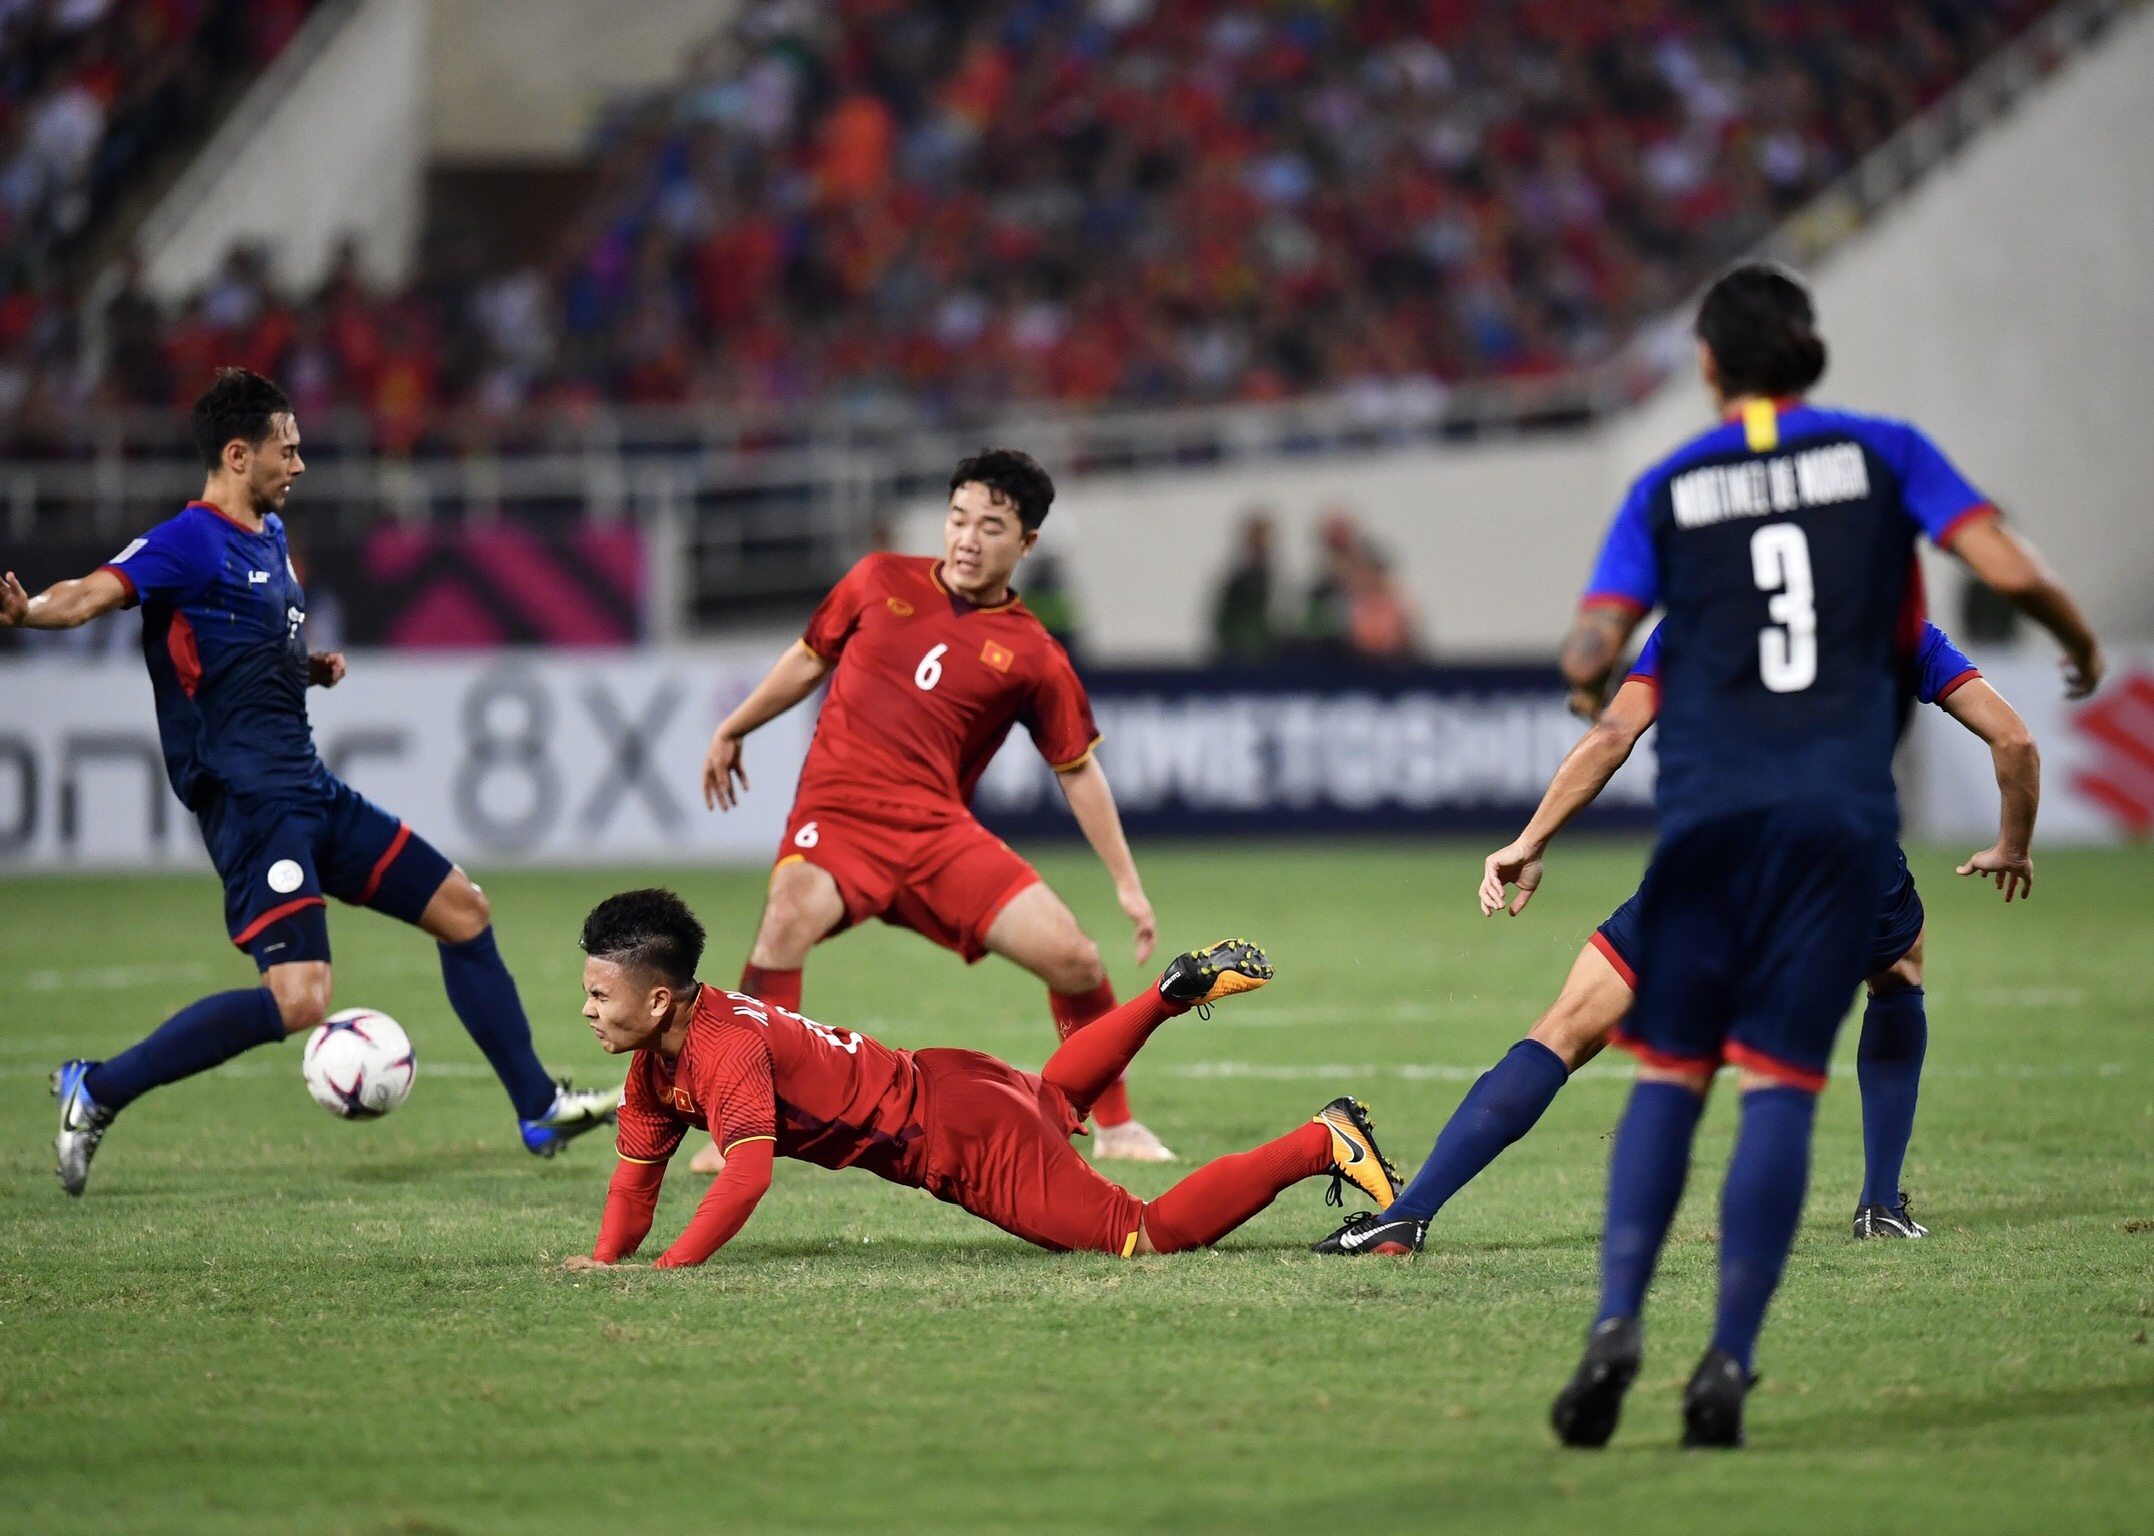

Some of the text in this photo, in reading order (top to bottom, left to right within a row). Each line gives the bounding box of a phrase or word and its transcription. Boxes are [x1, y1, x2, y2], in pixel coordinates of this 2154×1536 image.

[1750, 521, 1818, 693] 3
[914, 642, 949, 691] 6
[794, 821, 820, 849] 6
